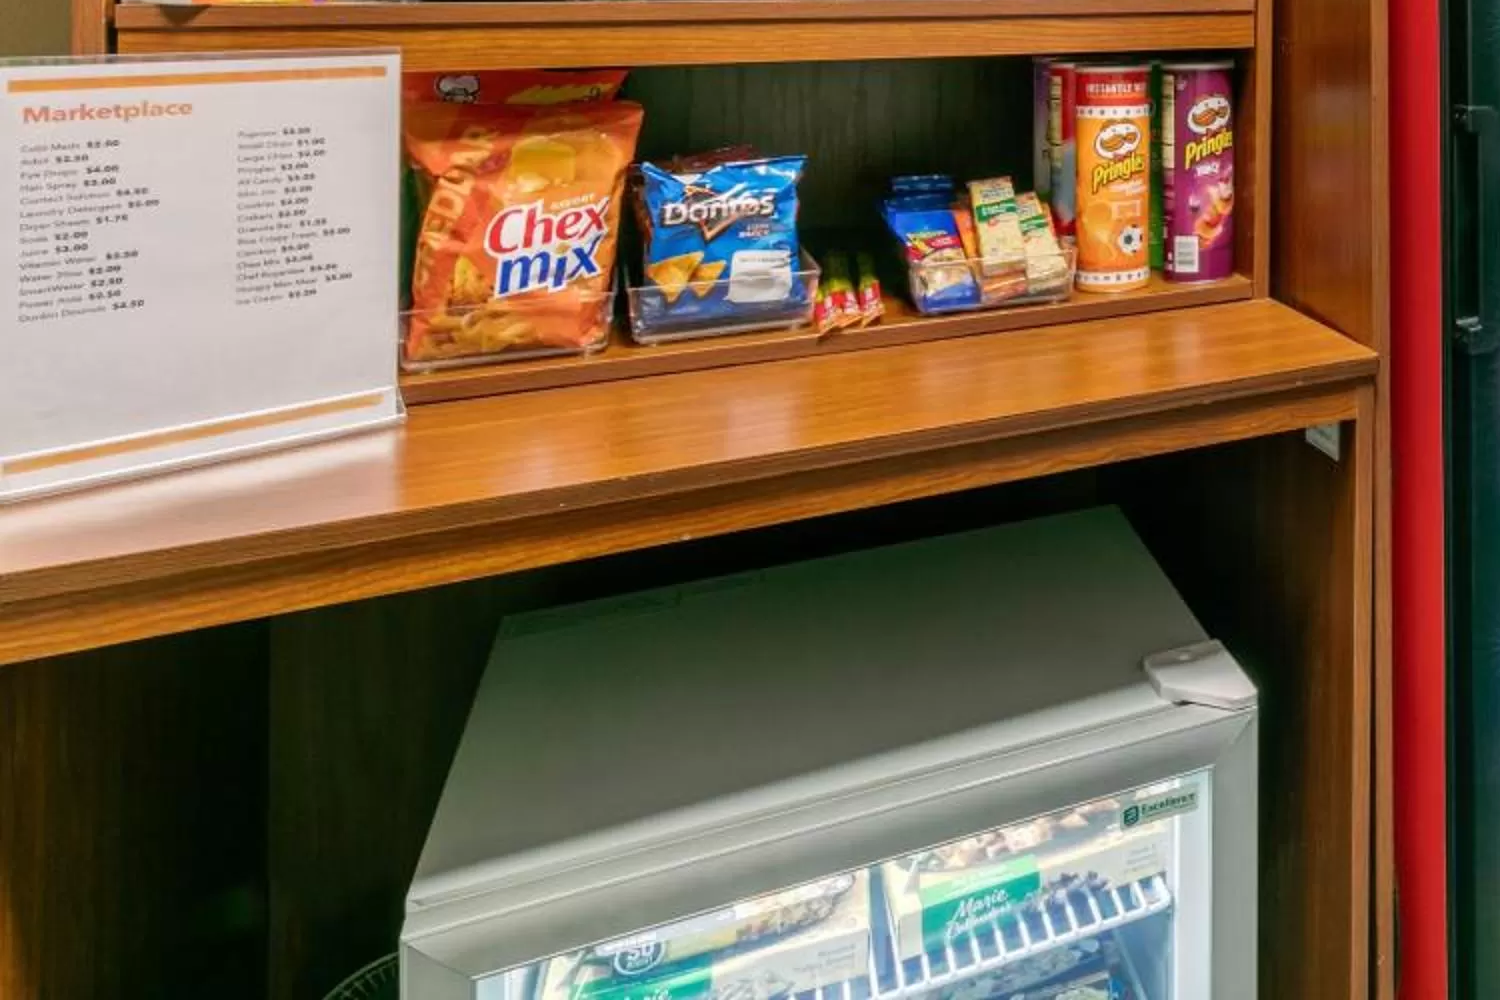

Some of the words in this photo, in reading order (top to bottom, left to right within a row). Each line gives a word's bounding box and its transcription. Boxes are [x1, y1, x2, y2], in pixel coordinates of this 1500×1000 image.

[22, 100, 193, 124] Marketplace
[487, 197, 609, 254] Chex
[663, 193, 775, 226] Doritos
[498, 232, 603, 295] mix
